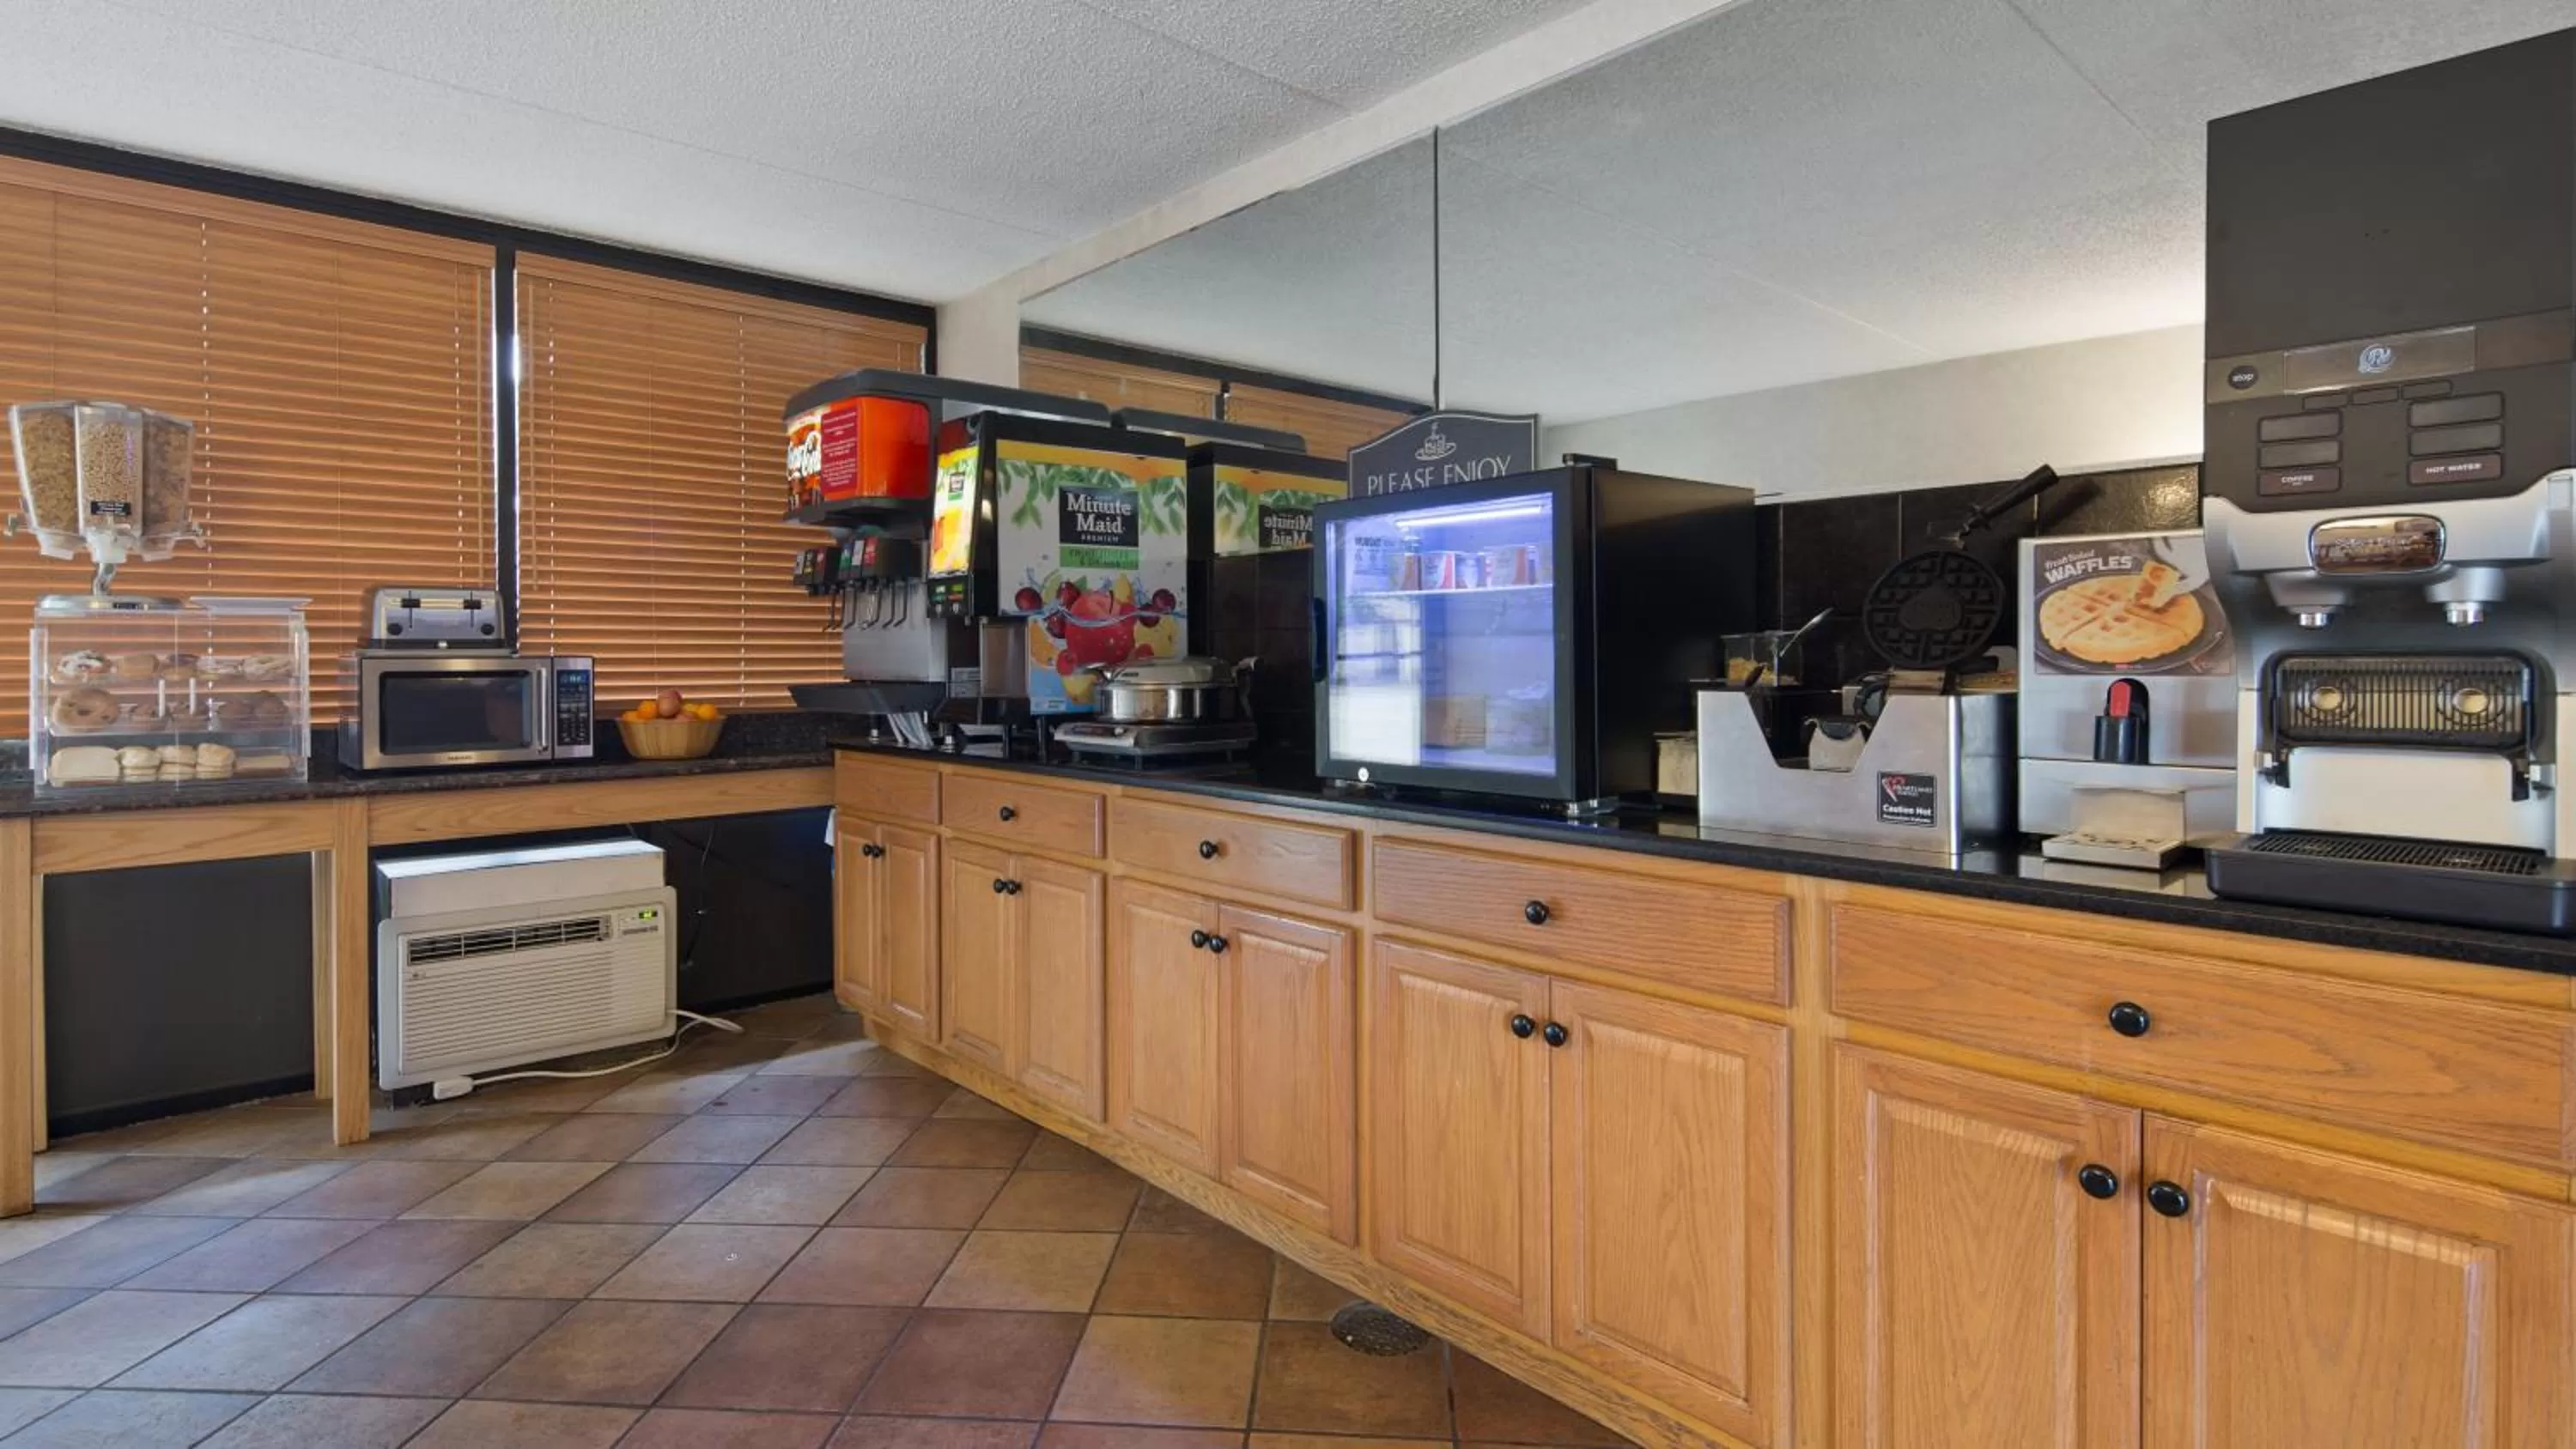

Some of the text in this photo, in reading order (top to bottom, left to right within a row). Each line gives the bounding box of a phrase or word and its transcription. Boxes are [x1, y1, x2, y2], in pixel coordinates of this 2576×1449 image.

[1368, 455, 1511, 496] PLEASE ENJOY
[2281, 475, 2314, 483] COFFEE
[2426, 463, 2482, 475] HOT WATER
[1066, 493, 1132, 515] Minute
[1076, 513, 1124, 533] Maid
[2044, 555, 2133, 584] WAFFLES
[1882, 803, 1931, 816] Caution Hot
